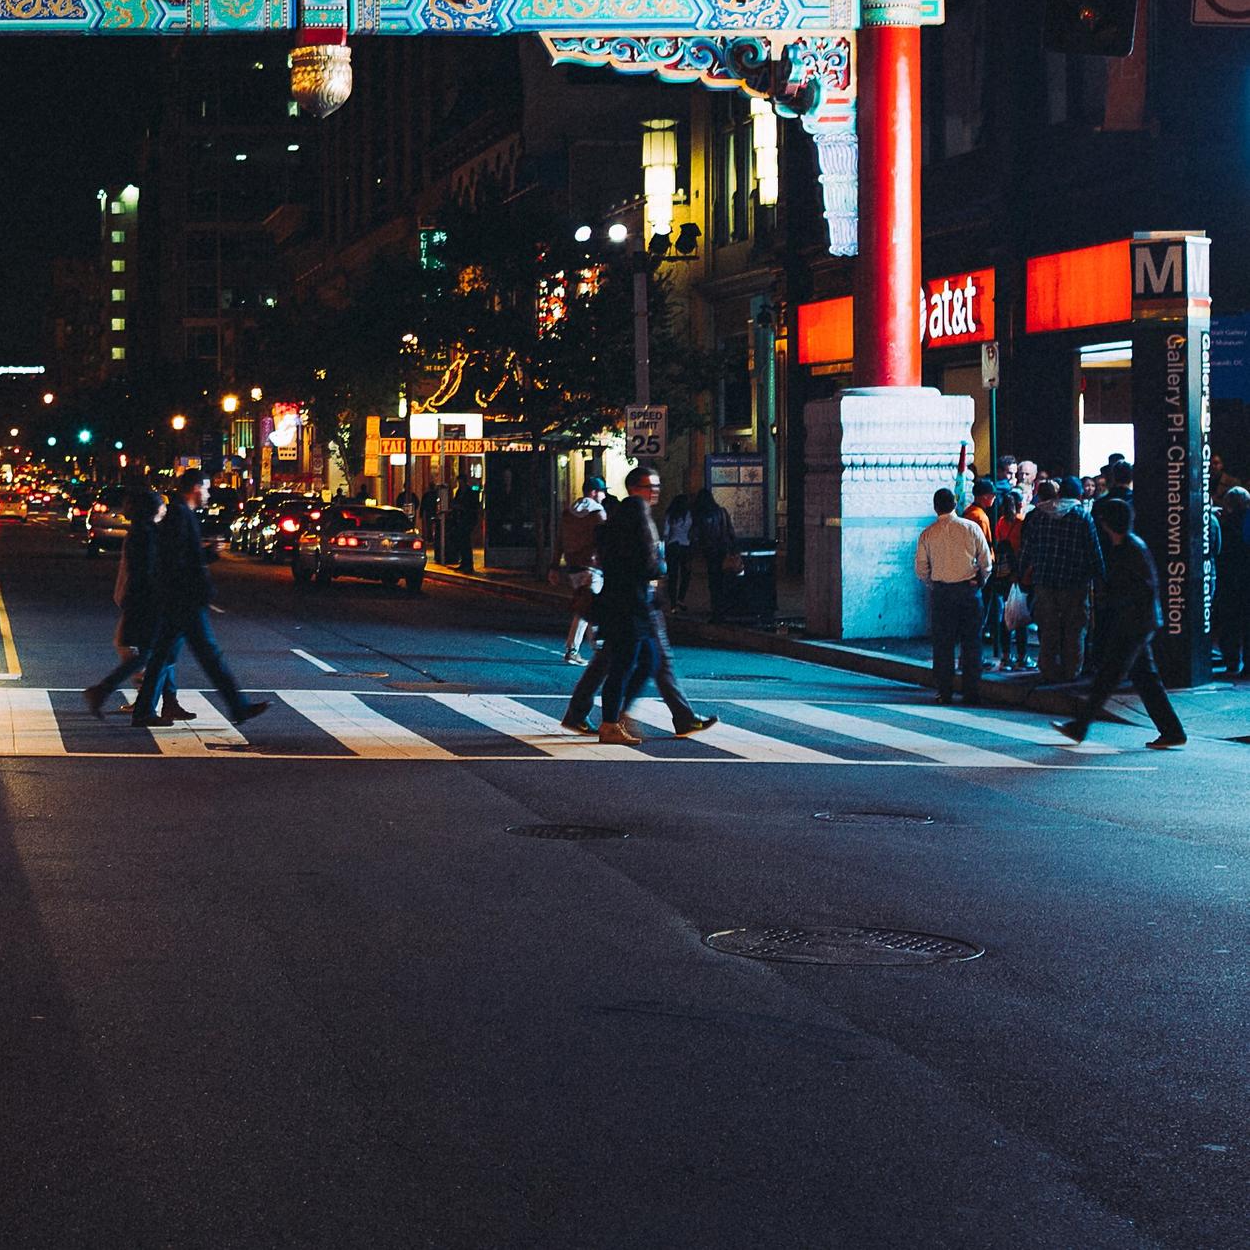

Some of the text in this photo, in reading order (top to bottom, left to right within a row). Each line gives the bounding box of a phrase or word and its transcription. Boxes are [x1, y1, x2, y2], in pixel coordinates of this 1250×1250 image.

[1135, 245, 1183, 294] M
[928, 275, 977, 339] at&t
[1166, 334, 1184, 406] Gallery
[630, 411, 663, 421] SPEED
[633, 421, 659, 430] LIMIT
[382, 440, 402, 453] TAI
[434, 440, 483, 453] CHINESE
[631, 434, 661, 455] 25
[1166, 561, 1187, 635] Station
[1201, 560, 1212, 634] Station
